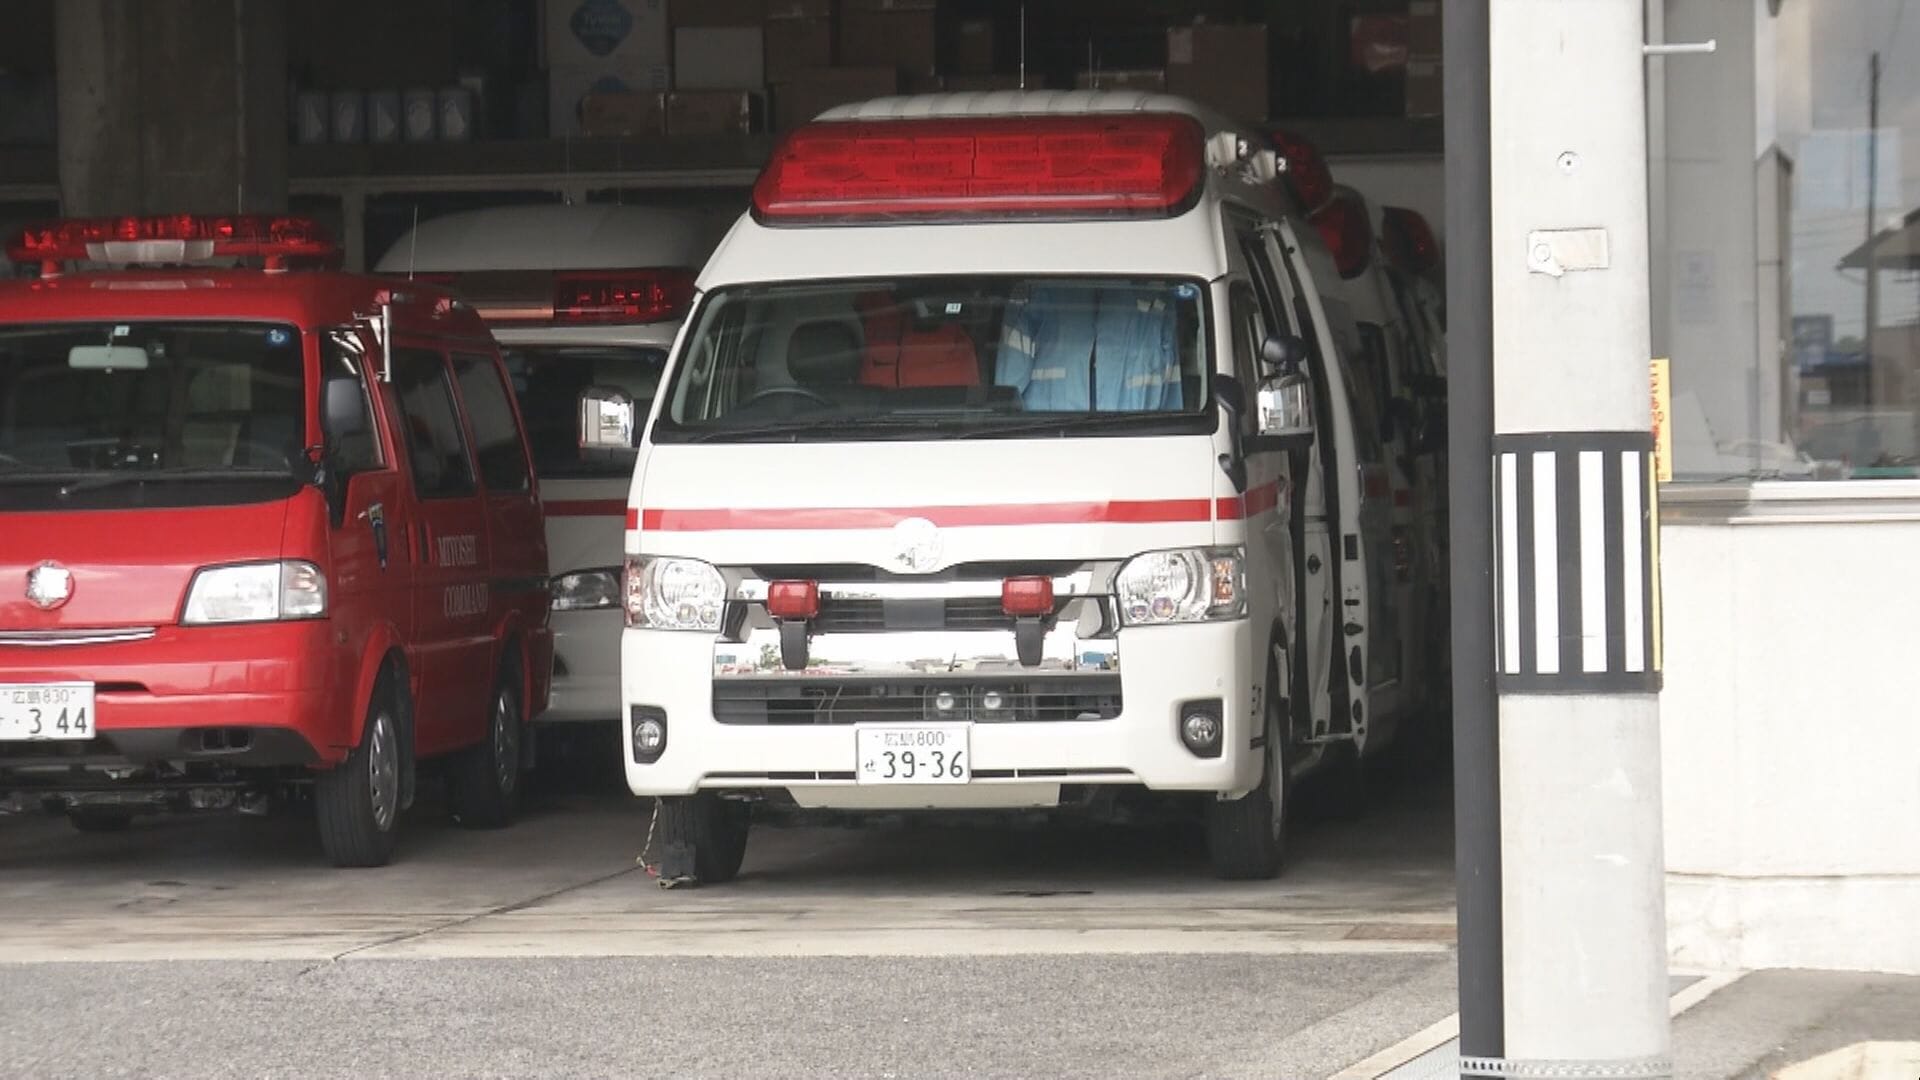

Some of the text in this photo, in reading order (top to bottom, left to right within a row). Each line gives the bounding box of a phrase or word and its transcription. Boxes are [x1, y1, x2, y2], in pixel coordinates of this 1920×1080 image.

[438, 534, 478, 568] MIYOSHI
[443, 583, 489, 619] COMMAND
[882, 750, 963, 778] 39-36
